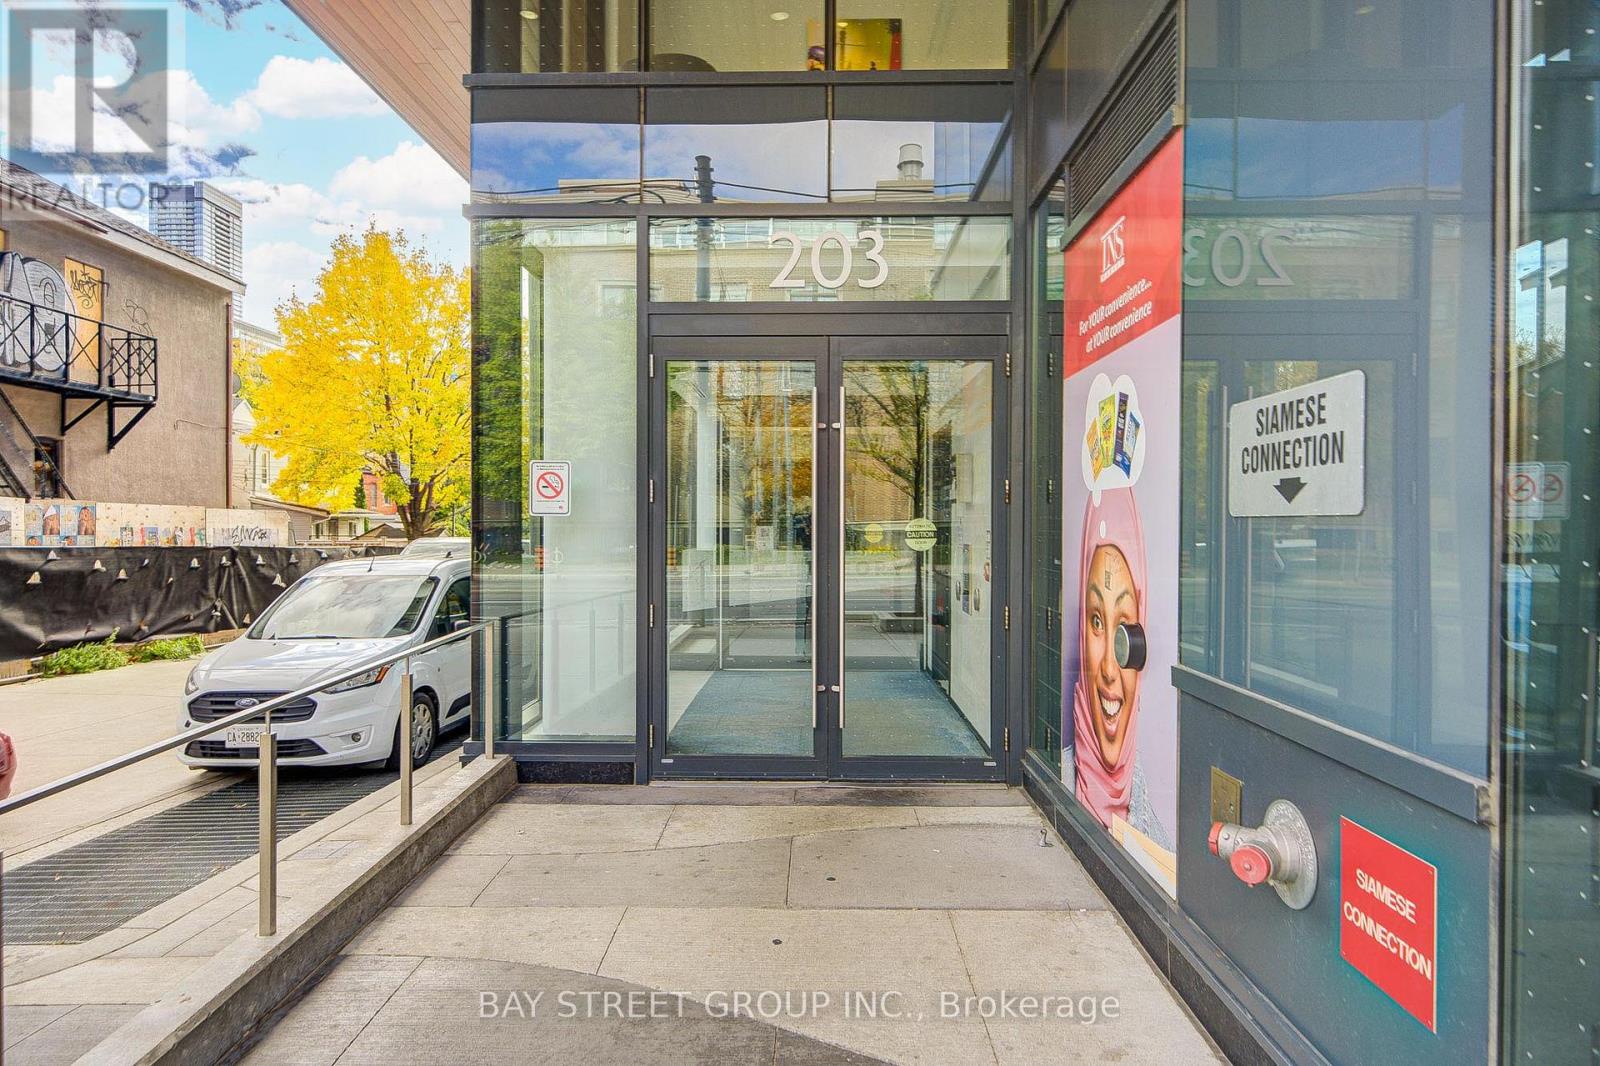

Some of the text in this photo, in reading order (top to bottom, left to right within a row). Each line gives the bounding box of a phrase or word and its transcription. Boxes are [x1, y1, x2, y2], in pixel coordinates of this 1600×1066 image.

[769, 231, 889, 289] 203
[1079, 320, 1090, 336] For
[1088, 305, 1105, 328] YOUR
[1092, 325, 1110, 349] YOUR
[1109, 301, 1152, 338] convenience
[1256, 392, 1327, 437] SIAMESE
[1241, 430, 1344, 475] CONNECTION
[241, 731, 263, 743] 2882
[1356, 868, 1417, 924] SIAMESE
[1343, 901, 1432, 981] CONNECTION
